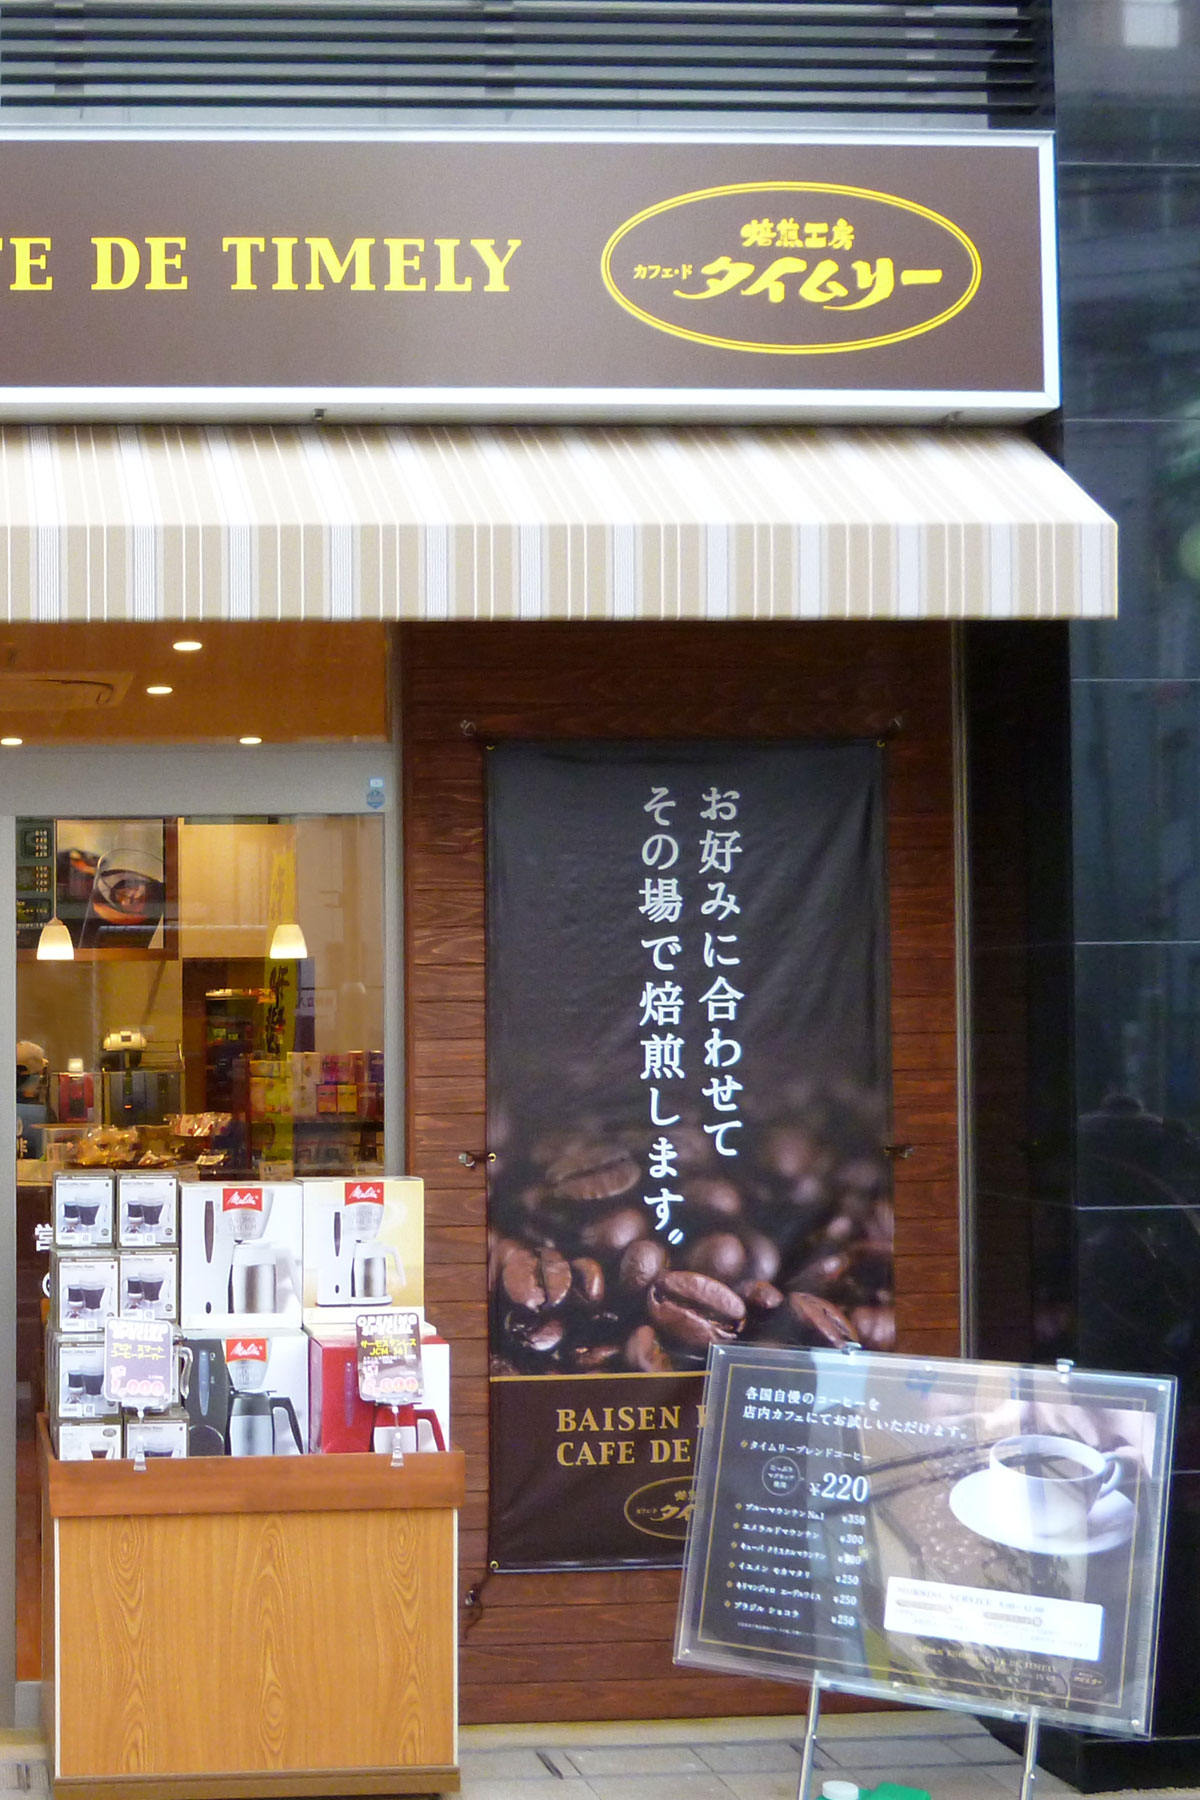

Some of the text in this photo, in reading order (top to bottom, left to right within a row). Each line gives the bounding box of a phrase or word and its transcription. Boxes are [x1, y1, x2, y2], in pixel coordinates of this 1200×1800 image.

[740, 218, 855, 250] 焙煎工房
[90, 236, 188, 291] DE
[223, 236, 523, 291] TIMELY
[673, 256, 943, 311] タイムリー
[698, 786, 745, 1157] お好みに合わせて
[745, 1386, 881, 1412] 各国自慢のコーヒーを
[556, 1406, 681, 1432] BAISEN
[742, 1405, 969, 1441] 店内カフェにてお試しいただけます。
[556, 1439, 691, 1466] CAFE DE
[749, 1440, 872, 1461] タイムリーブレンドコーヒー
[809, 1472, 869, 1502] ¥220
